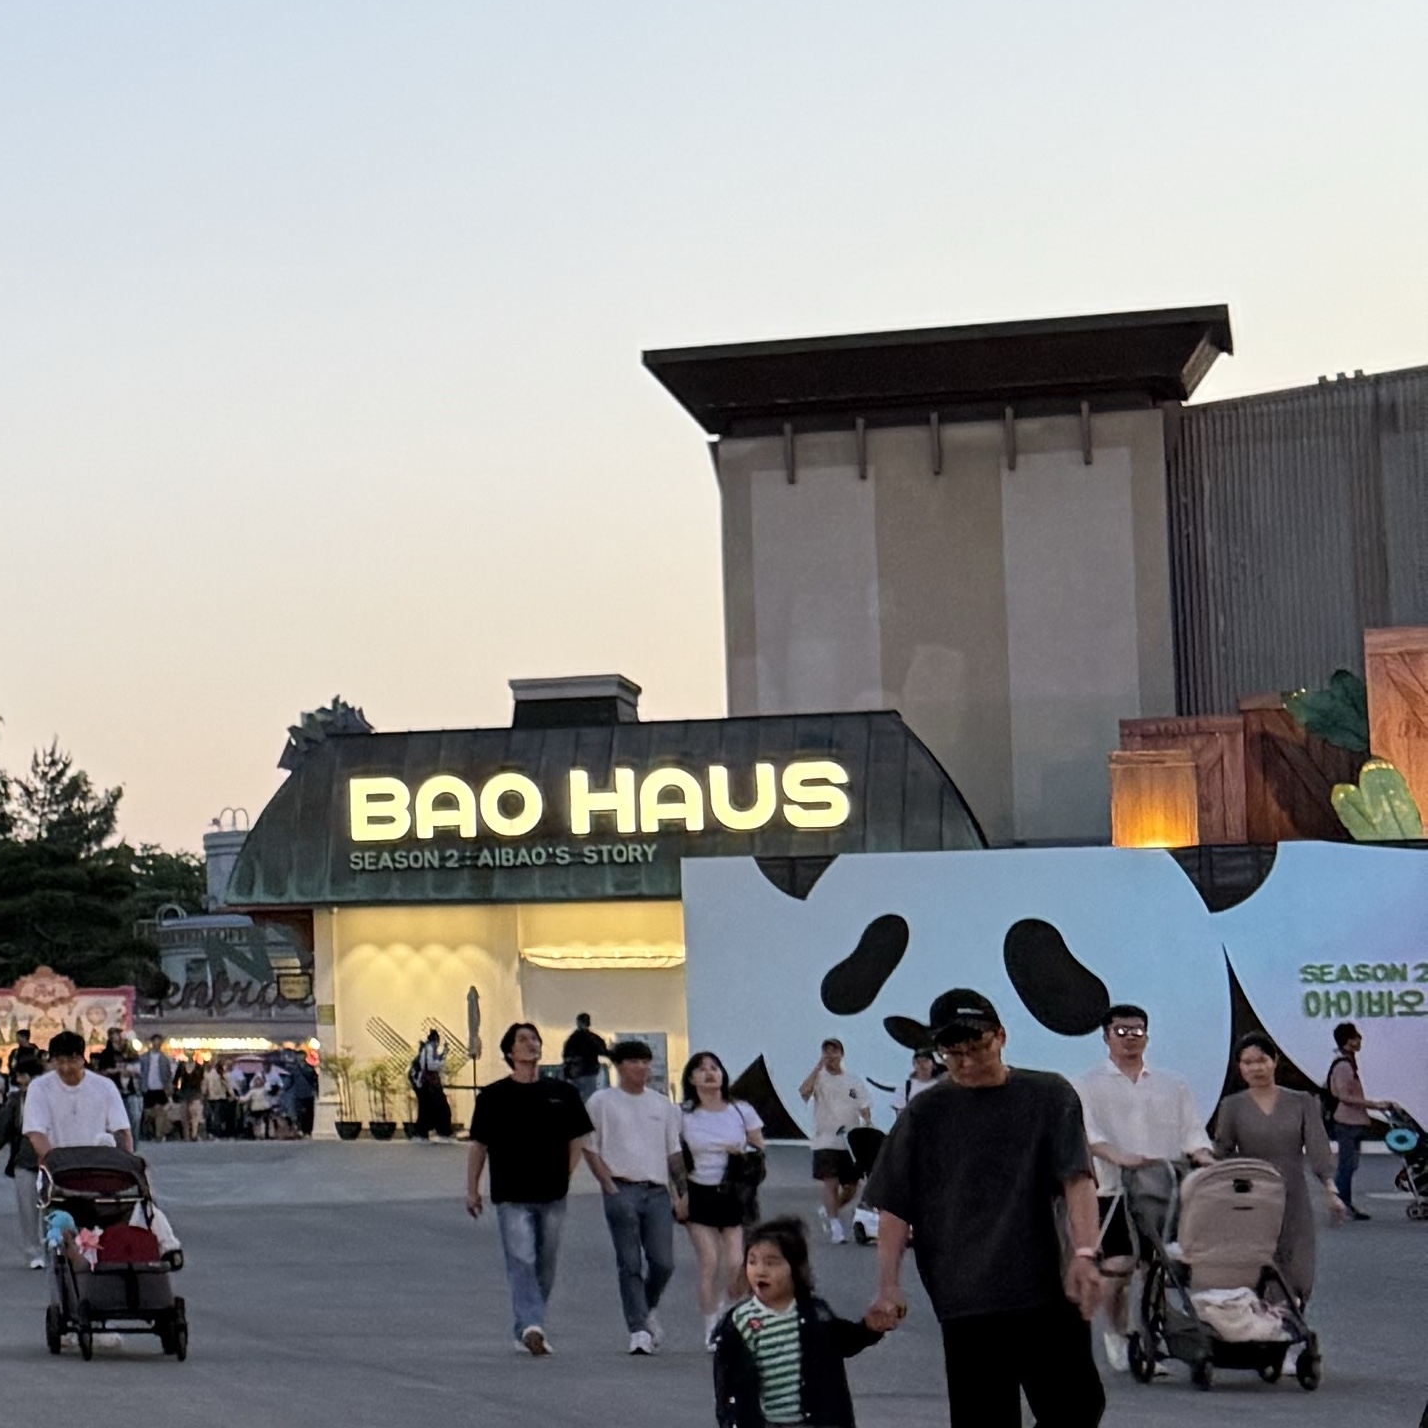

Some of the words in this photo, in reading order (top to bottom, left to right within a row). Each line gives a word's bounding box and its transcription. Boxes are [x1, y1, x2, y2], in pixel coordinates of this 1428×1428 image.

[349, 772, 543, 842] BAO
[569, 760, 850, 835] HAUS
[349, 849, 440, 870] SEASON
[477, 845, 571, 868] AIBAO'S
[583, 843, 658, 865] STORY
[1299, 962, 1408, 983] SEASON
